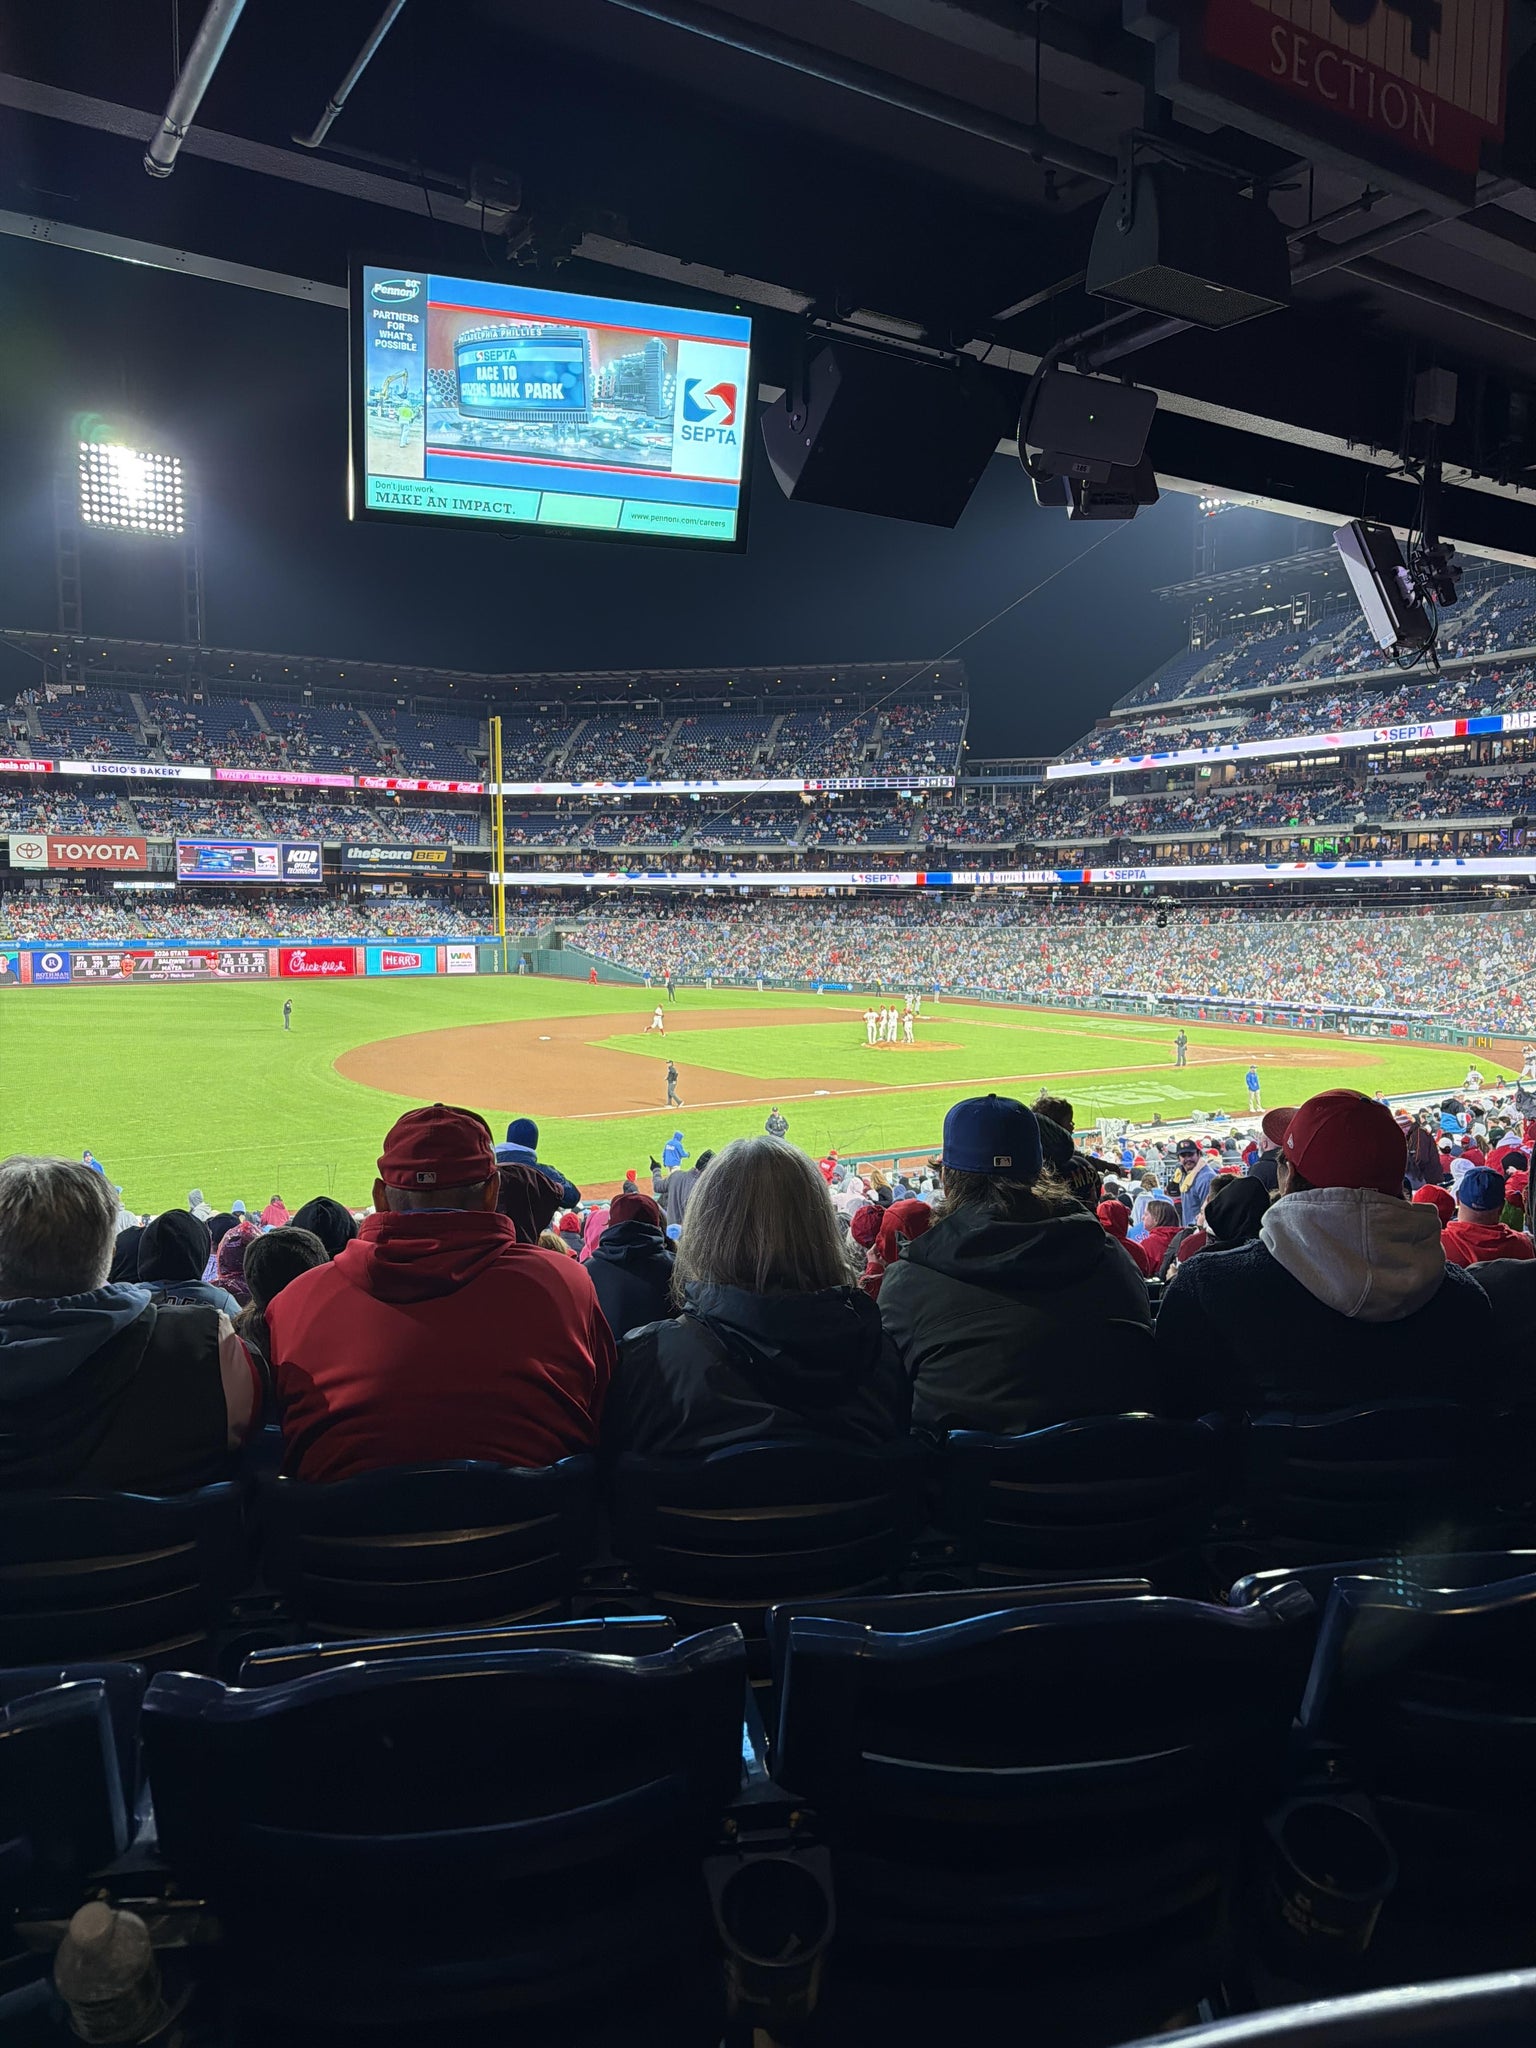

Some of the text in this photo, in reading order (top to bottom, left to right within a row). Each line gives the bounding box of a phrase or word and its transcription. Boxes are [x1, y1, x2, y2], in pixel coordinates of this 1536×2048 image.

[1270, 24, 1436, 146] SECTION
[374, 283, 416, 298] Pennoni
[373, 309, 419, 323] PARTNERS
[387, 321, 405, 331] FOR
[379, 330, 413, 342] WHAT'S
[501, 328, 542, 337] PHILLIES
[375, 339, 417, 352] POSSIBLE
[484, 349, 517, 361] SEPTA
[477, 365, 517, 381] RACE TO
[490, 383, 520, 398] BANK
[525, 383, 564, 399] PARK
[681, 425, 737, 445] SEPTA
[375, 481, 396, 490] Don't
[397, 484, 413, 492] just
[376, 491, 516, 514] MAKE AN IMPACT.
[631, 513, 726, 528] www.pennoni.com/careers
[1389, 725, 1434, 740] SEPTA
[20, 762, 35, 770] roll
[36, 762, 46, 771] in
[92, 764, 181, 776] LISCIO'S BAKERY
[53, 844, 140, 860] TOYOTA
[287, 850, 318, 862] KDI
[347, 847, 412, 860] theScore
[416, 852, 444, 860] BET
[865, 874, 900, 883] SEPTA
[1115, 870, 1146, 880] SEPTA
[385, 955, 417, 966] HERR'S
